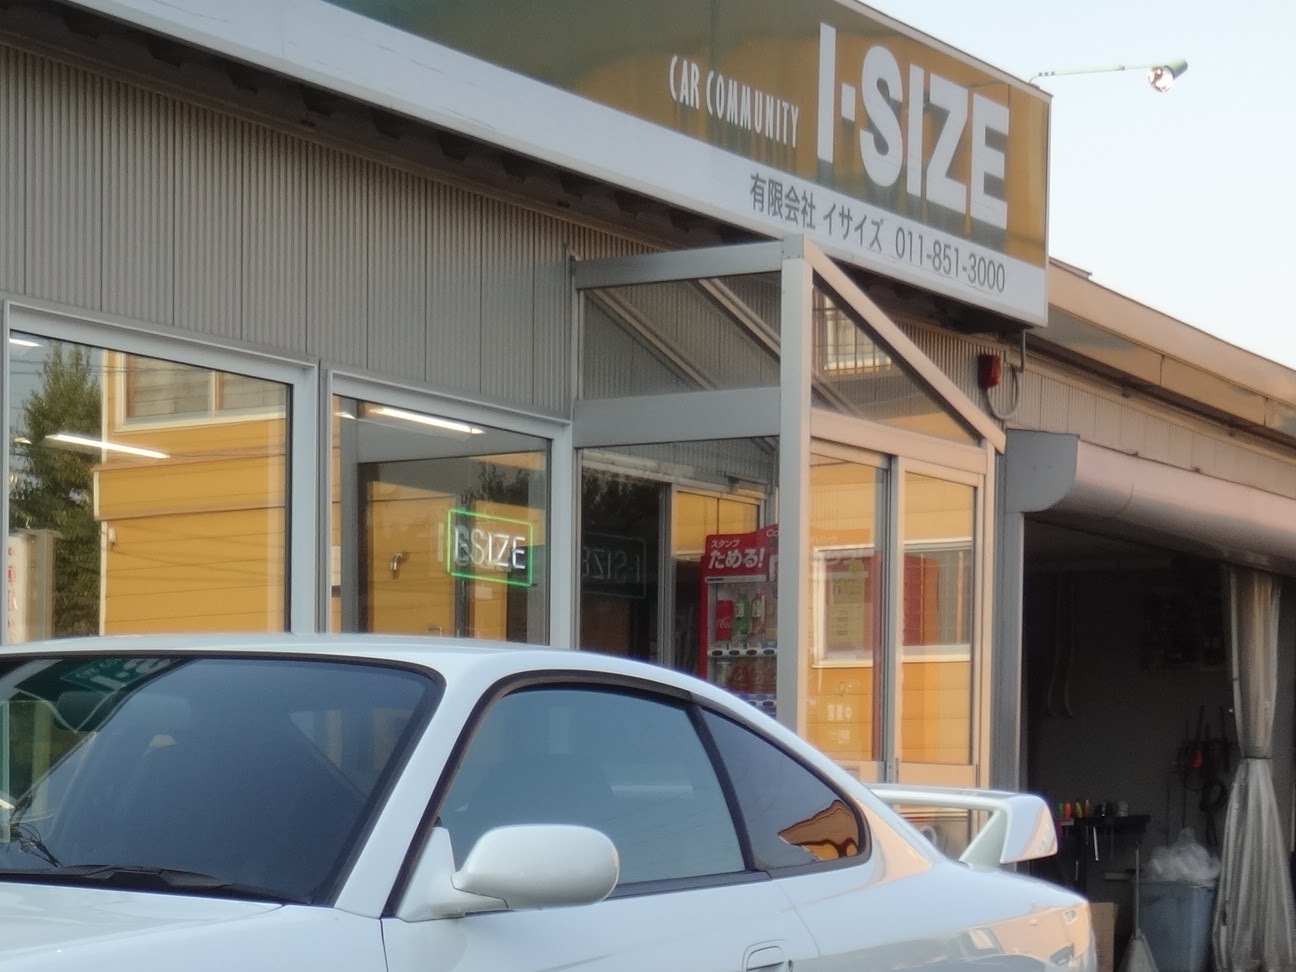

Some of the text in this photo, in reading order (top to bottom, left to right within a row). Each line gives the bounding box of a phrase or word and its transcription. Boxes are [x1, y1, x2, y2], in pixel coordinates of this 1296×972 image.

[669, 55, 799, 148] CAR COMMUNITY
[749, 172, 1006, 293] 有限会社 イサイズ 011-851-3000
